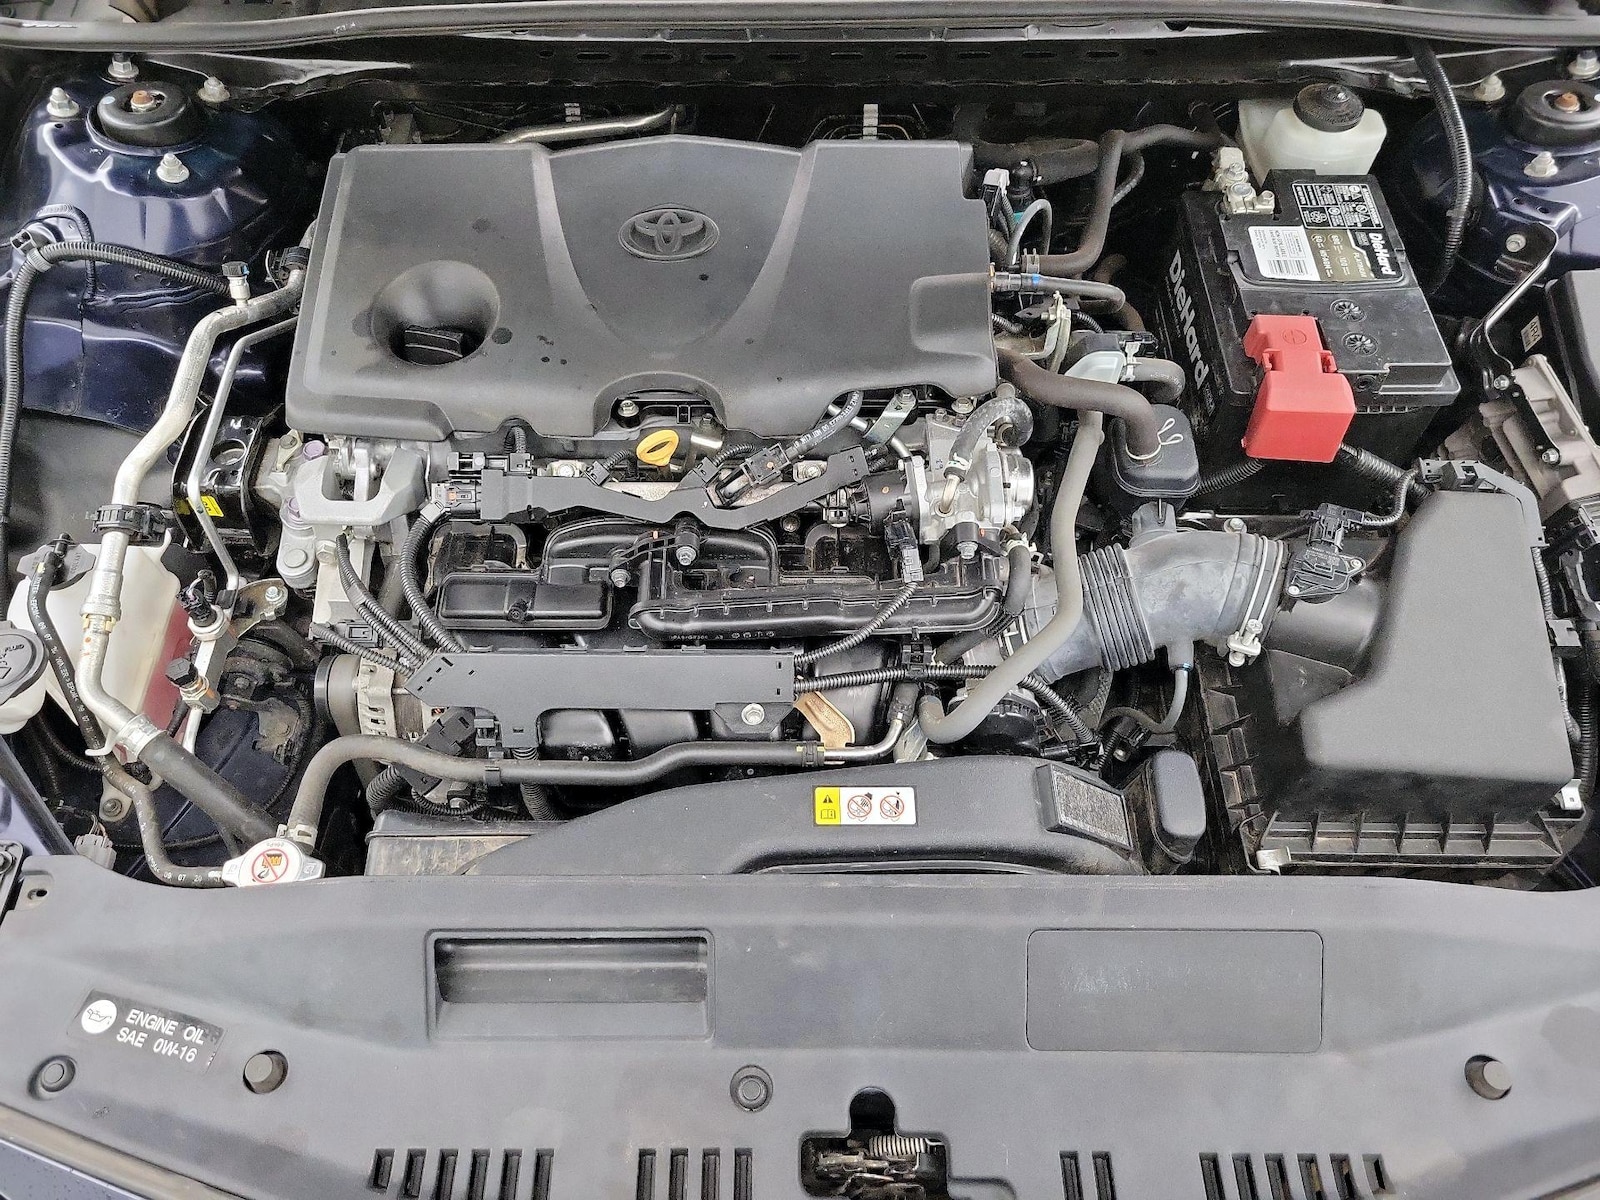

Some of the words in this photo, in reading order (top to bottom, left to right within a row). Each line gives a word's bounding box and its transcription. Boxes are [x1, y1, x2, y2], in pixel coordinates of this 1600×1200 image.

[1368, 232, 1397, 275] DieHard
[1169, 249, 1210, 390] DieHard
[177, 874, 187, 882] 07
[116, 1027, 148, 1048] SAE
[153, 1038, 198, 1063] 0W-16
[126, 1009, 179, 1036] ENGINE
[183, 1026, 204, 1045] OIL
